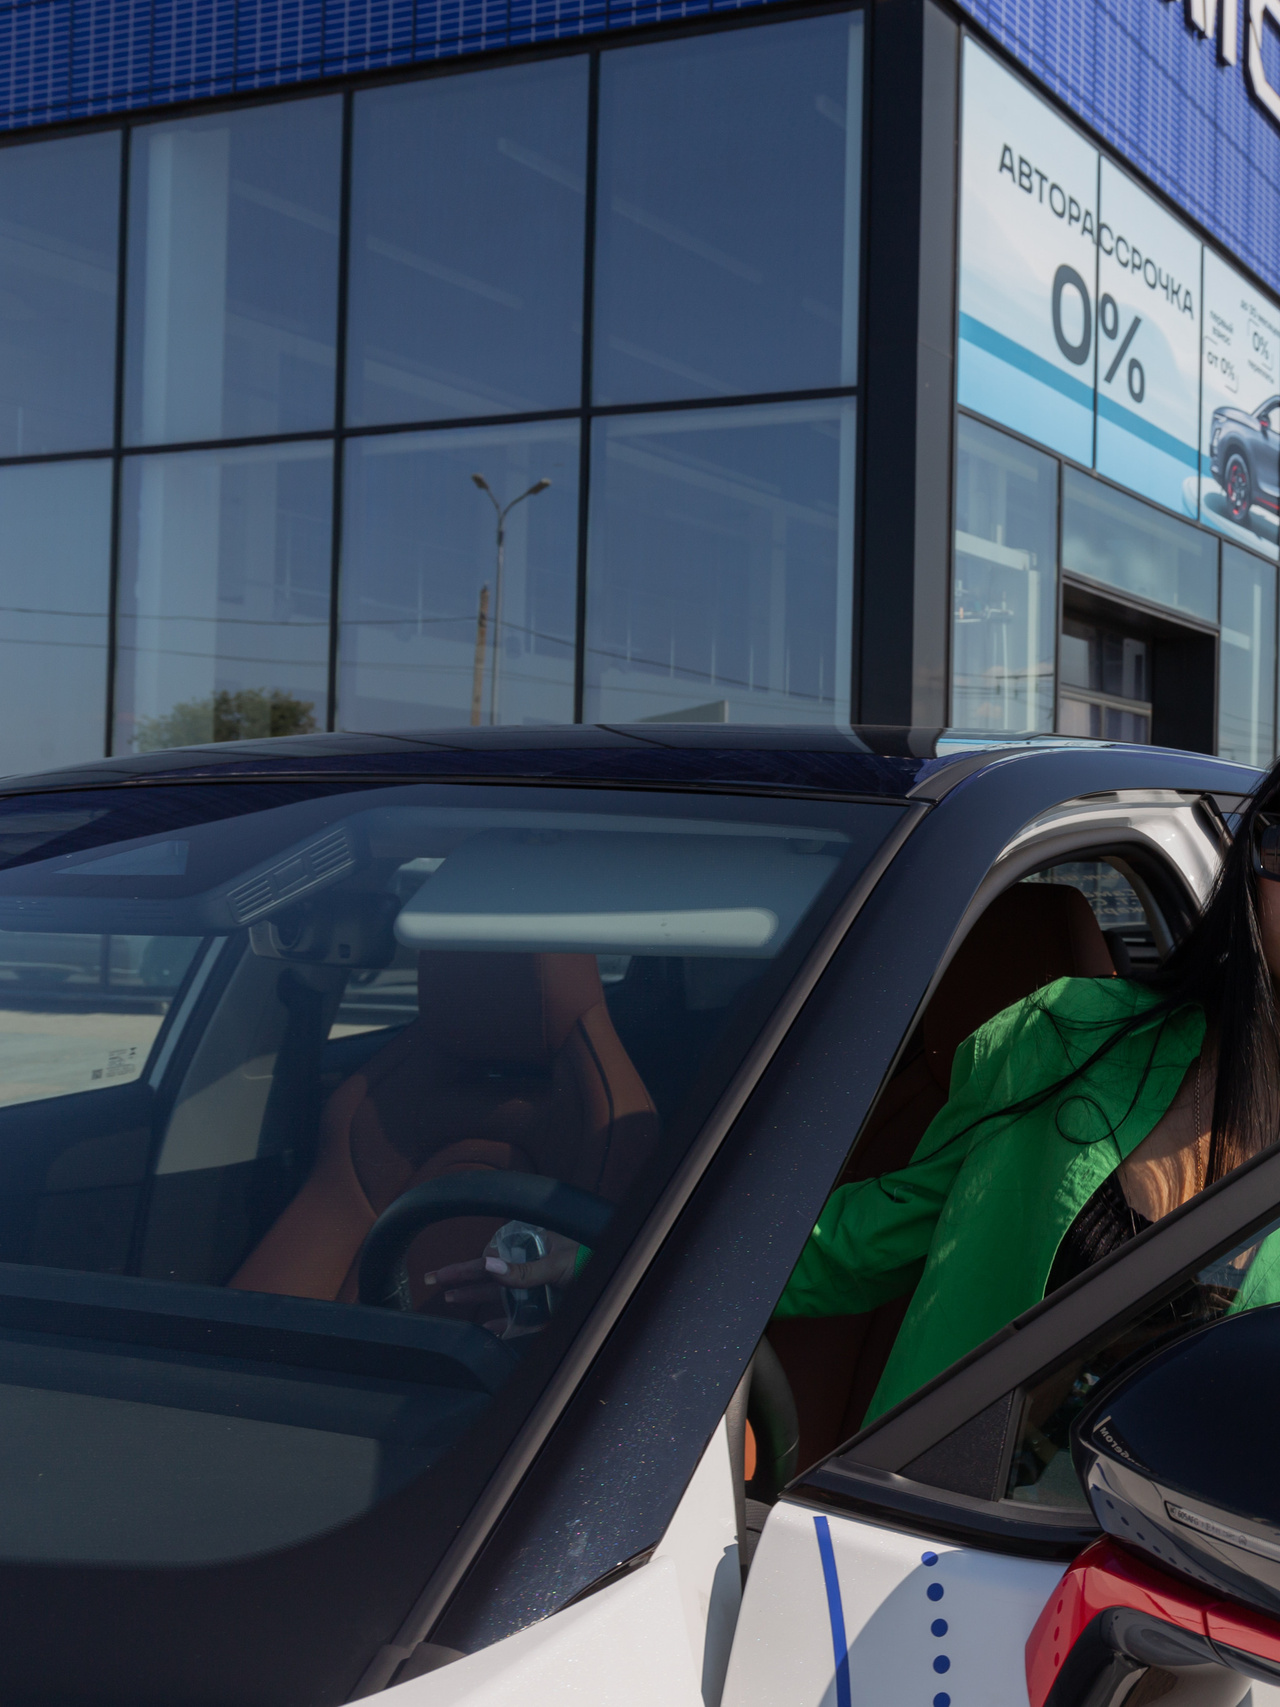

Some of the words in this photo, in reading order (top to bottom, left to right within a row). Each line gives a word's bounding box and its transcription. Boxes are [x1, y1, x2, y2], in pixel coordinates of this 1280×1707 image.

[998, 143, 1195, 321] АВТОРАССРОЧКА
[1052, 263, 1145, 404] 0%
[1206, 351, 1218, 369] от
[1221, 357, 1236, 382] 0%
[1252, 331, 1270, 361] 0%
